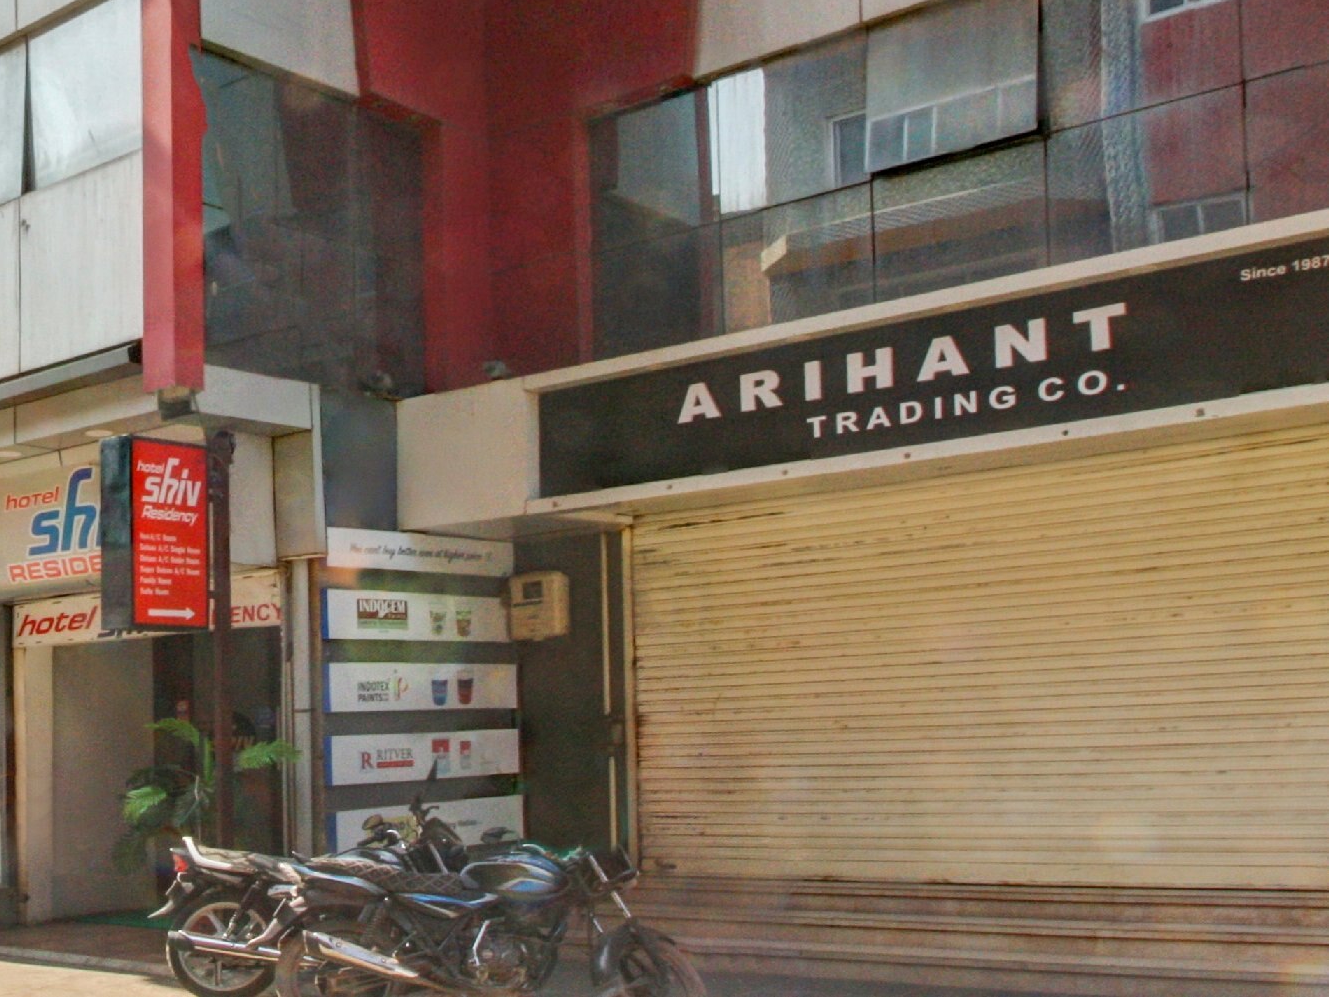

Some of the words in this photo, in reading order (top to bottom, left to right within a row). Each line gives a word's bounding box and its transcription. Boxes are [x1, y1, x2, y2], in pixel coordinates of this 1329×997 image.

[1240, 264, 1287, 281] Since
[1291, 254, 1329, 271] 1987
[678, 302, 1128, 425] ARIHANT
[806, 385, 1017, 439] TRADING
[1037, 368, 1128, 403] CO.
[136, 459, 165, 474] hotel
[140, 457, 202, 507] shiv
[141, 504, 199, 527] Residency
[9, 554, 102, 583] RESIDE
[18, 605, 99, 638] hotel
[357, 693, 384, 702] PAINTS
